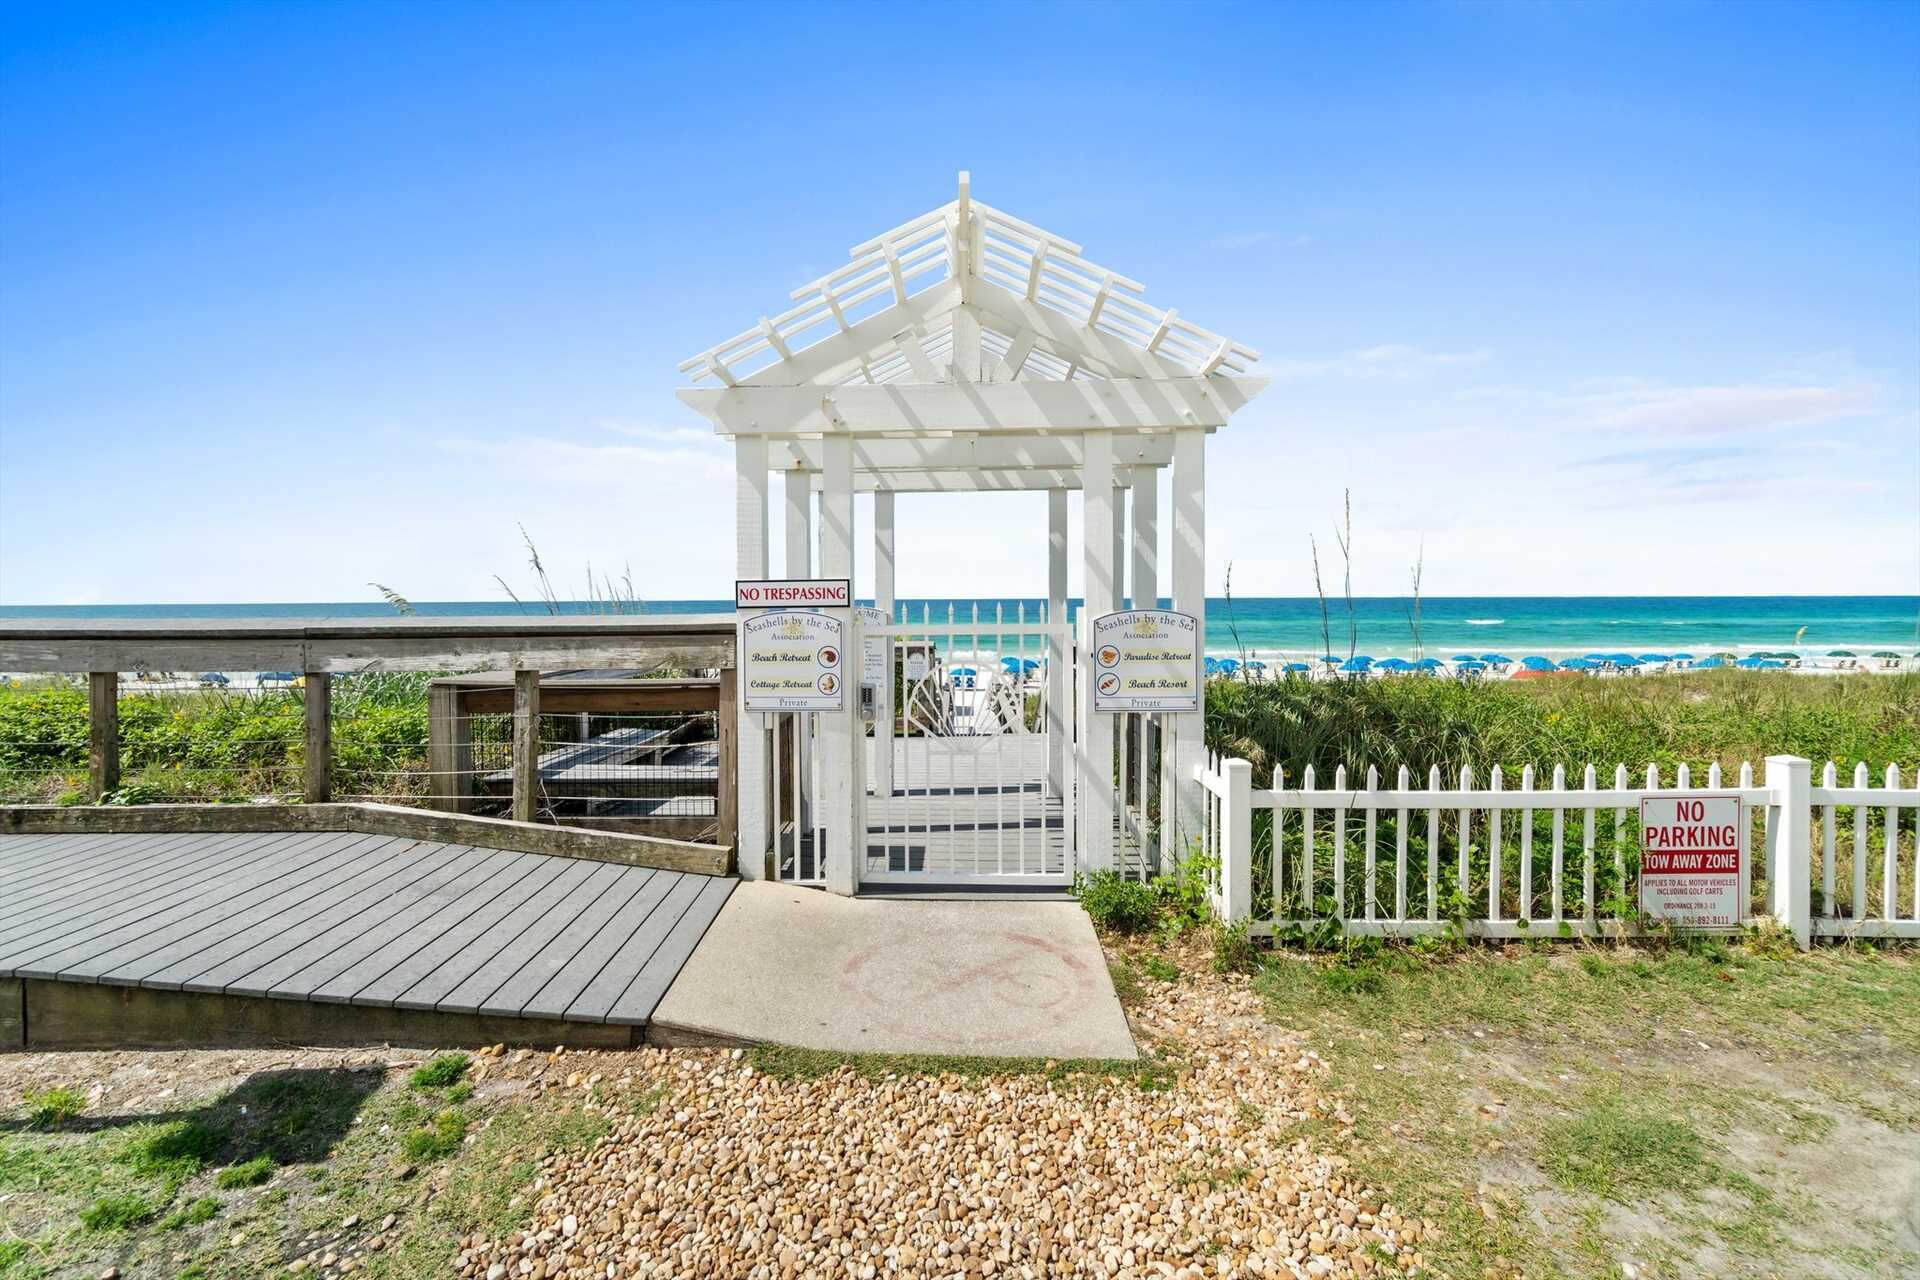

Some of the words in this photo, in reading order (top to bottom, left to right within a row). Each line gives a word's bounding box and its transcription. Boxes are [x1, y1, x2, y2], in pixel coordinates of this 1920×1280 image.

[740, 588, 760, 600] NO
[763, 587, 846, 600] TRESPASSING
[746, 615, 788, 633] Seashells
[792, 615, 803, 626] by
[807, 617, 821, 628] the
[824, 622, 840, 634] Sea
[1096, 614, 1141, 633] Seashells
[1144, 613, 1157, 625] by
[1160, 615, 1176, 626] the
[1179, 619, 1195, 632] Sea
[771, 633, 815, 641] Association
[1123, 632, 1169, 640] Association
[752, 653, 778, 662] Beach
[780, 653, 812, 662] Retreat
[1123, 652, 1160, 661] Paradise
[1161, 652, 1192, 661] Retreat
[750, 680, 780, 691] Cottage
[782, 680, 813, 689] Retreat
[1128, 680, 1156, 689] Beach
[1157, 680, 1188, 689] Resort
[779, 698, 808, 707] Private
[1129, 699, 1162, 708] Private
[1676, 801, 1705, 822] NO
[1645, 825, 1736, 848] PARKING
[1645, 854, 1670, 869] TOW
[1672, 854, 1703, 869] AWAY
[1706, 853, 1737, 869] ZONE
[1644, 879, 1667, 887] APPLIES
[1668, 879, 1676, 887] TO
[1677, 879, 1688, 887] ALL
[1710, 878, 1737, 886] VEHICLES
[1656, 888, 1688, 896] INCLUDING
[1689, 888, 1703, 896] GOLF
[1705, 887, 1724, 896] CARTS
[1663, 902, 1693, 910] ORDINANCE
